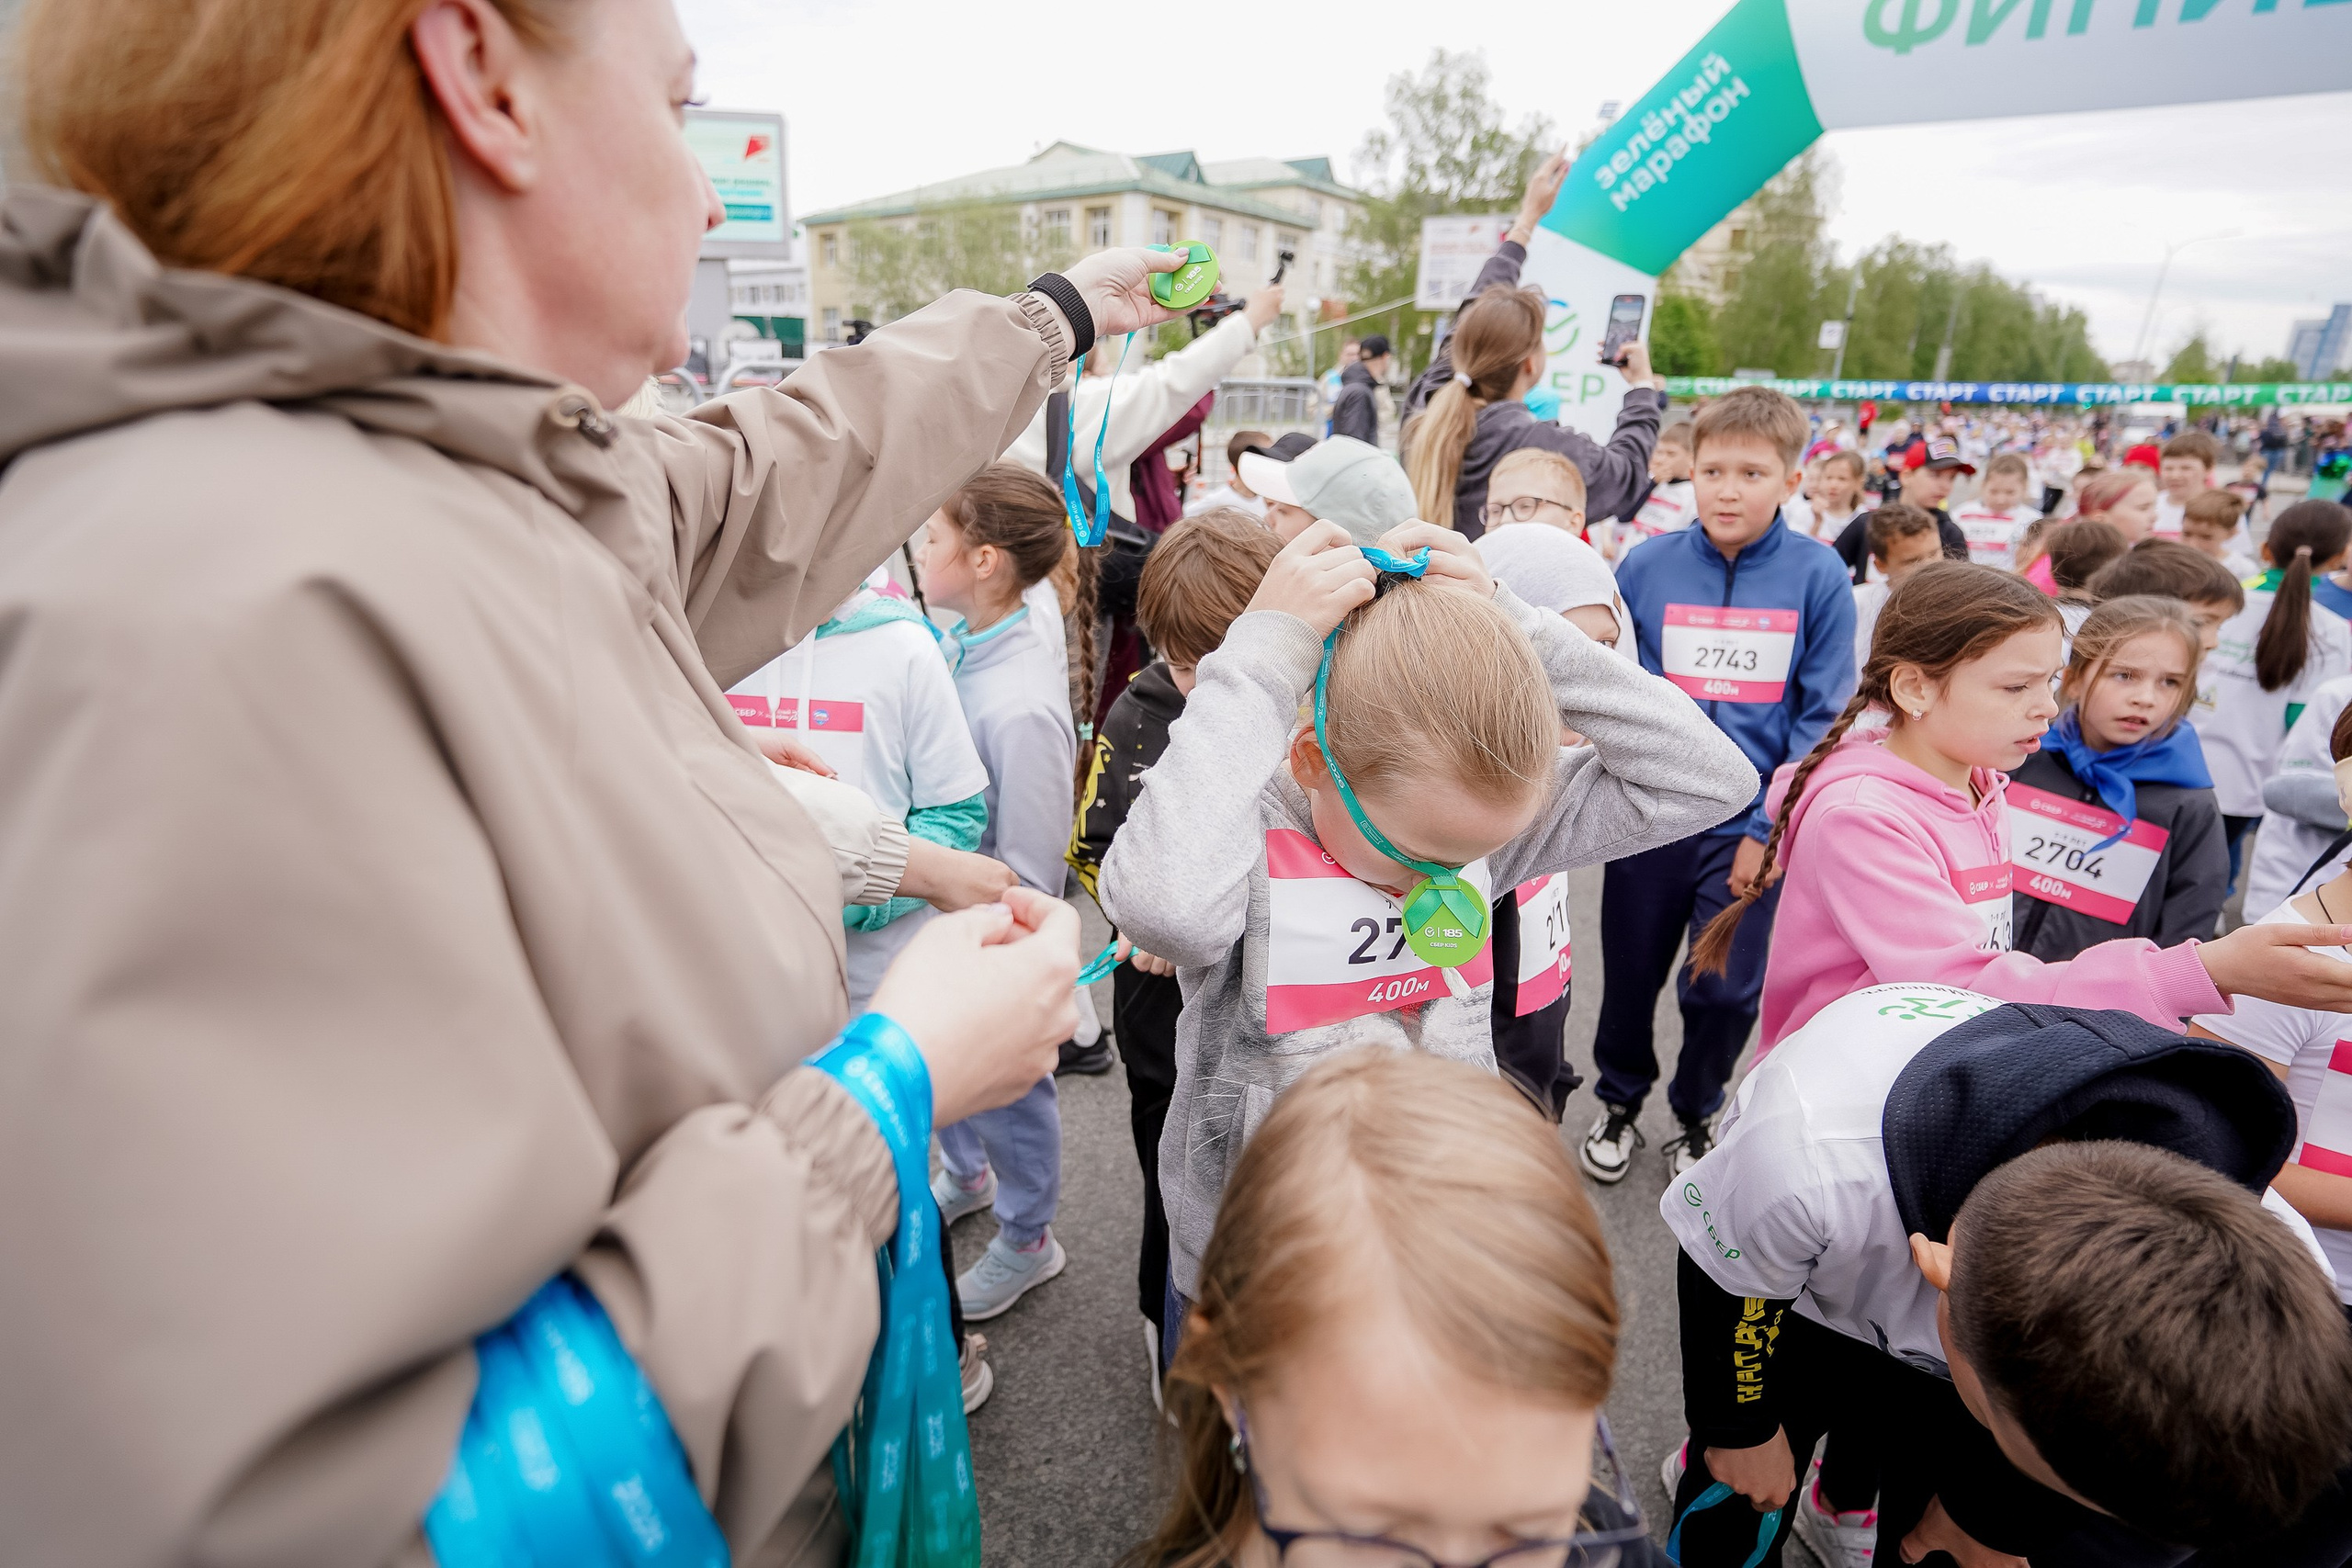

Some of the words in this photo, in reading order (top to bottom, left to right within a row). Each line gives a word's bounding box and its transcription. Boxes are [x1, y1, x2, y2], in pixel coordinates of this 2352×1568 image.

[1594, 51, 1732, 190] зелёный
[1610, 76, 1751, 212] марафон
[1551, 372, 1605, 403] ЕР
[1830, 380, 1897, 400] СТАРТ
[1905, 381, 1977, 401] СТАРТ
[1987, 383, 2065, 403] СТАРТ
[2075, 383, 2159, 404] СТАРТ
[2171, 383, 2261, 405] СТАРТ
[2275, 383, 2352, 405] СТАР
[1695, 647, 1758, 671] 2743
[2025, 836, 2105, 879] 2704
[1348, 917, 1418, 965] 27
[1442, 929, 1463, 938] 185
[1702, 1210, 1741, 1260] СБЕР
